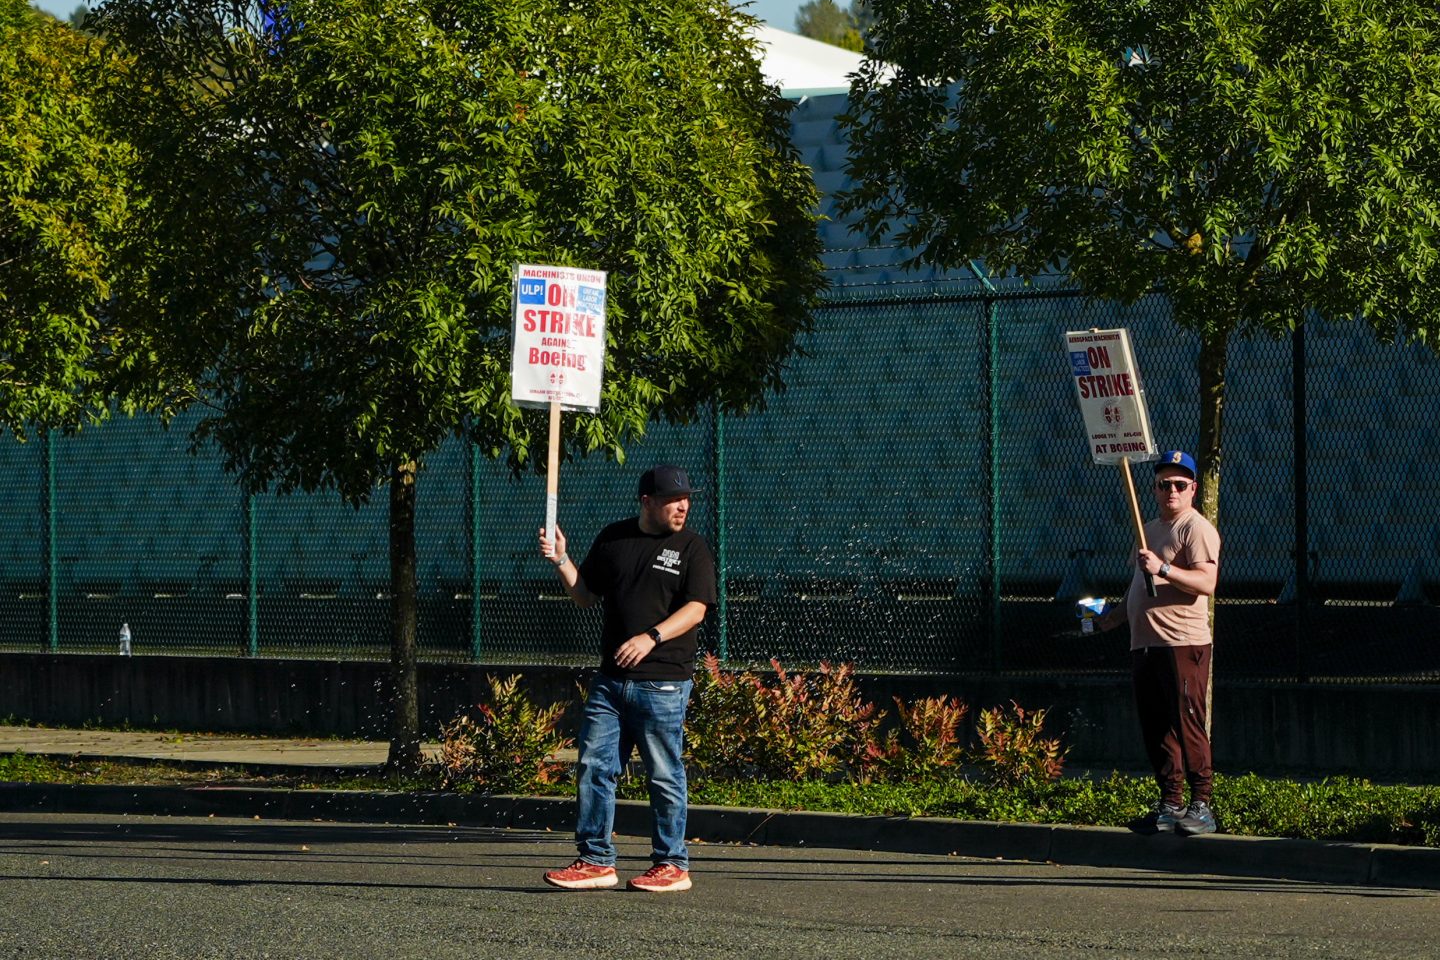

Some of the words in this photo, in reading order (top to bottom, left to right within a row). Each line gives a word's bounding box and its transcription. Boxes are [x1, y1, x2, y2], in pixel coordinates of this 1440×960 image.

[523, 269, 575, 280] MACHINISTS
[576, 272, 601, 283] UNION
[521, 284, 544, 296] ULP!
[547, 283, 577, 308] ON
[523, 309, 596, 337] STRIKE
[528, 347, 587, 371] Boeing
[1087, 346, 1111, 369] ON
[1078, 373, 1134, 399] STRIKE
[1095, 444, 1107, 454] AT
[1110, 442, 1146, 453] BOEING
